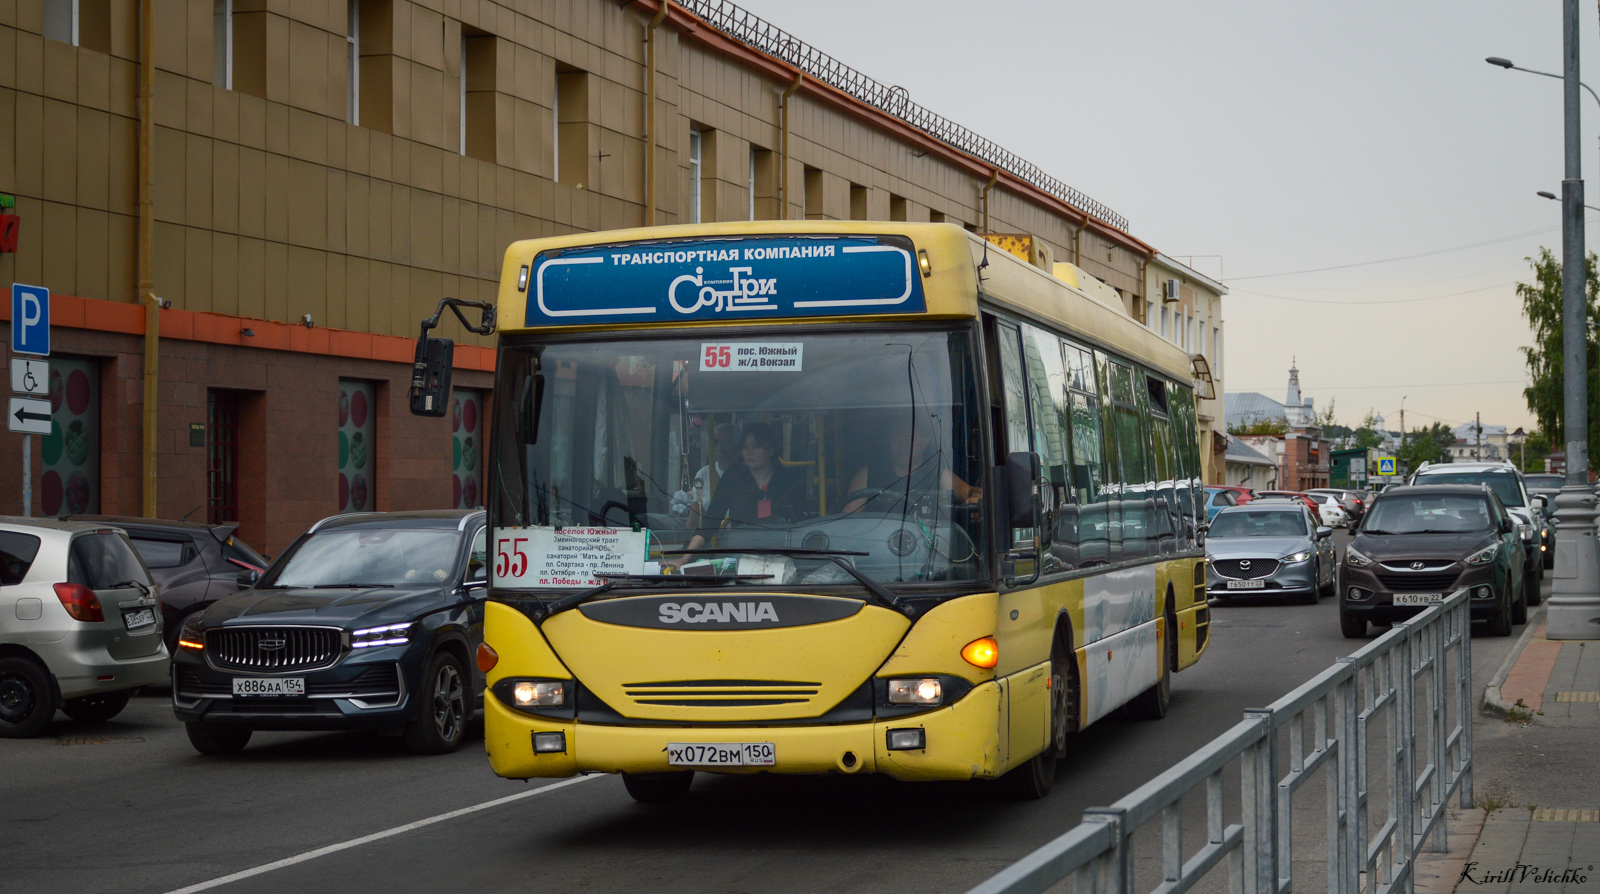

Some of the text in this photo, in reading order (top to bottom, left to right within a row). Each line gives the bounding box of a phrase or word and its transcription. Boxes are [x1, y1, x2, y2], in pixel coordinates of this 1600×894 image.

[611, 246, 834, 266] ТРАНСПОРТНАЯ КОМПАНИЯ
[704, 346, 731, 368] 55
[738, 346, 797, 356] пос. Южный
[738, 358, 796, 367] ж/д Вокзал
[496, 538, 528, 578] 55
[658, 602, 779, 623] SCANIA
[237, 680, 301, 692] Х886АА 154
[674, 745, 770, 763] Х072ВМ 150
